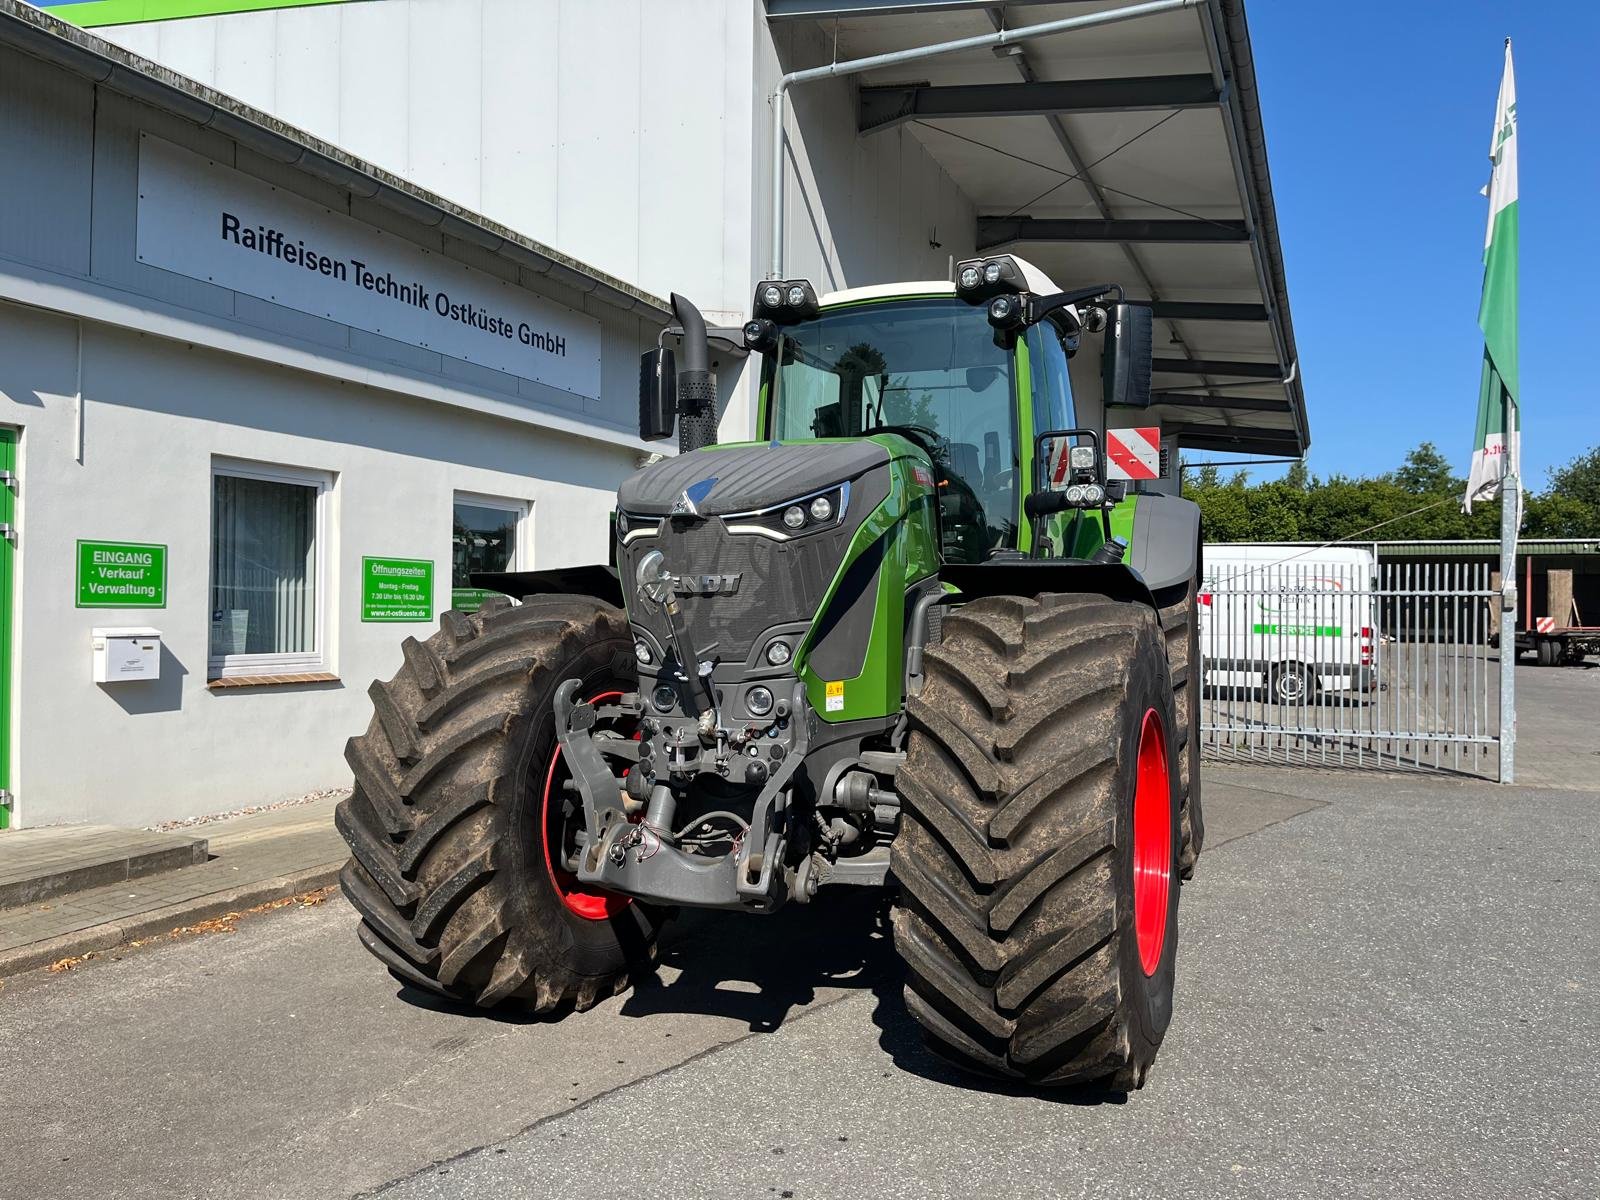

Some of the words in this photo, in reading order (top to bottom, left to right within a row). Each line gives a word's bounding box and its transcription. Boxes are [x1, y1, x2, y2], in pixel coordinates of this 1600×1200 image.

[221, 212, 347, 281] Raiffeisen
[350, 259, 429, 312] Technik
[434, 292, 514, 340] Ostküste
[518, 322, 567, 358] GmbH
[93, 550, 153, 565] EINGANG
[98, 567, 145, 580] Verkauf
[371, 562, 426, 577] Öffnungszeiten
[88, 582, 155, 598] Verwaltung
[378, 582, 398, 591] Montag
[401, 583, 419, 592] Freitag
[671, 574, 743, 593] ENDT
[383, 592, 393, 600] Uhr
